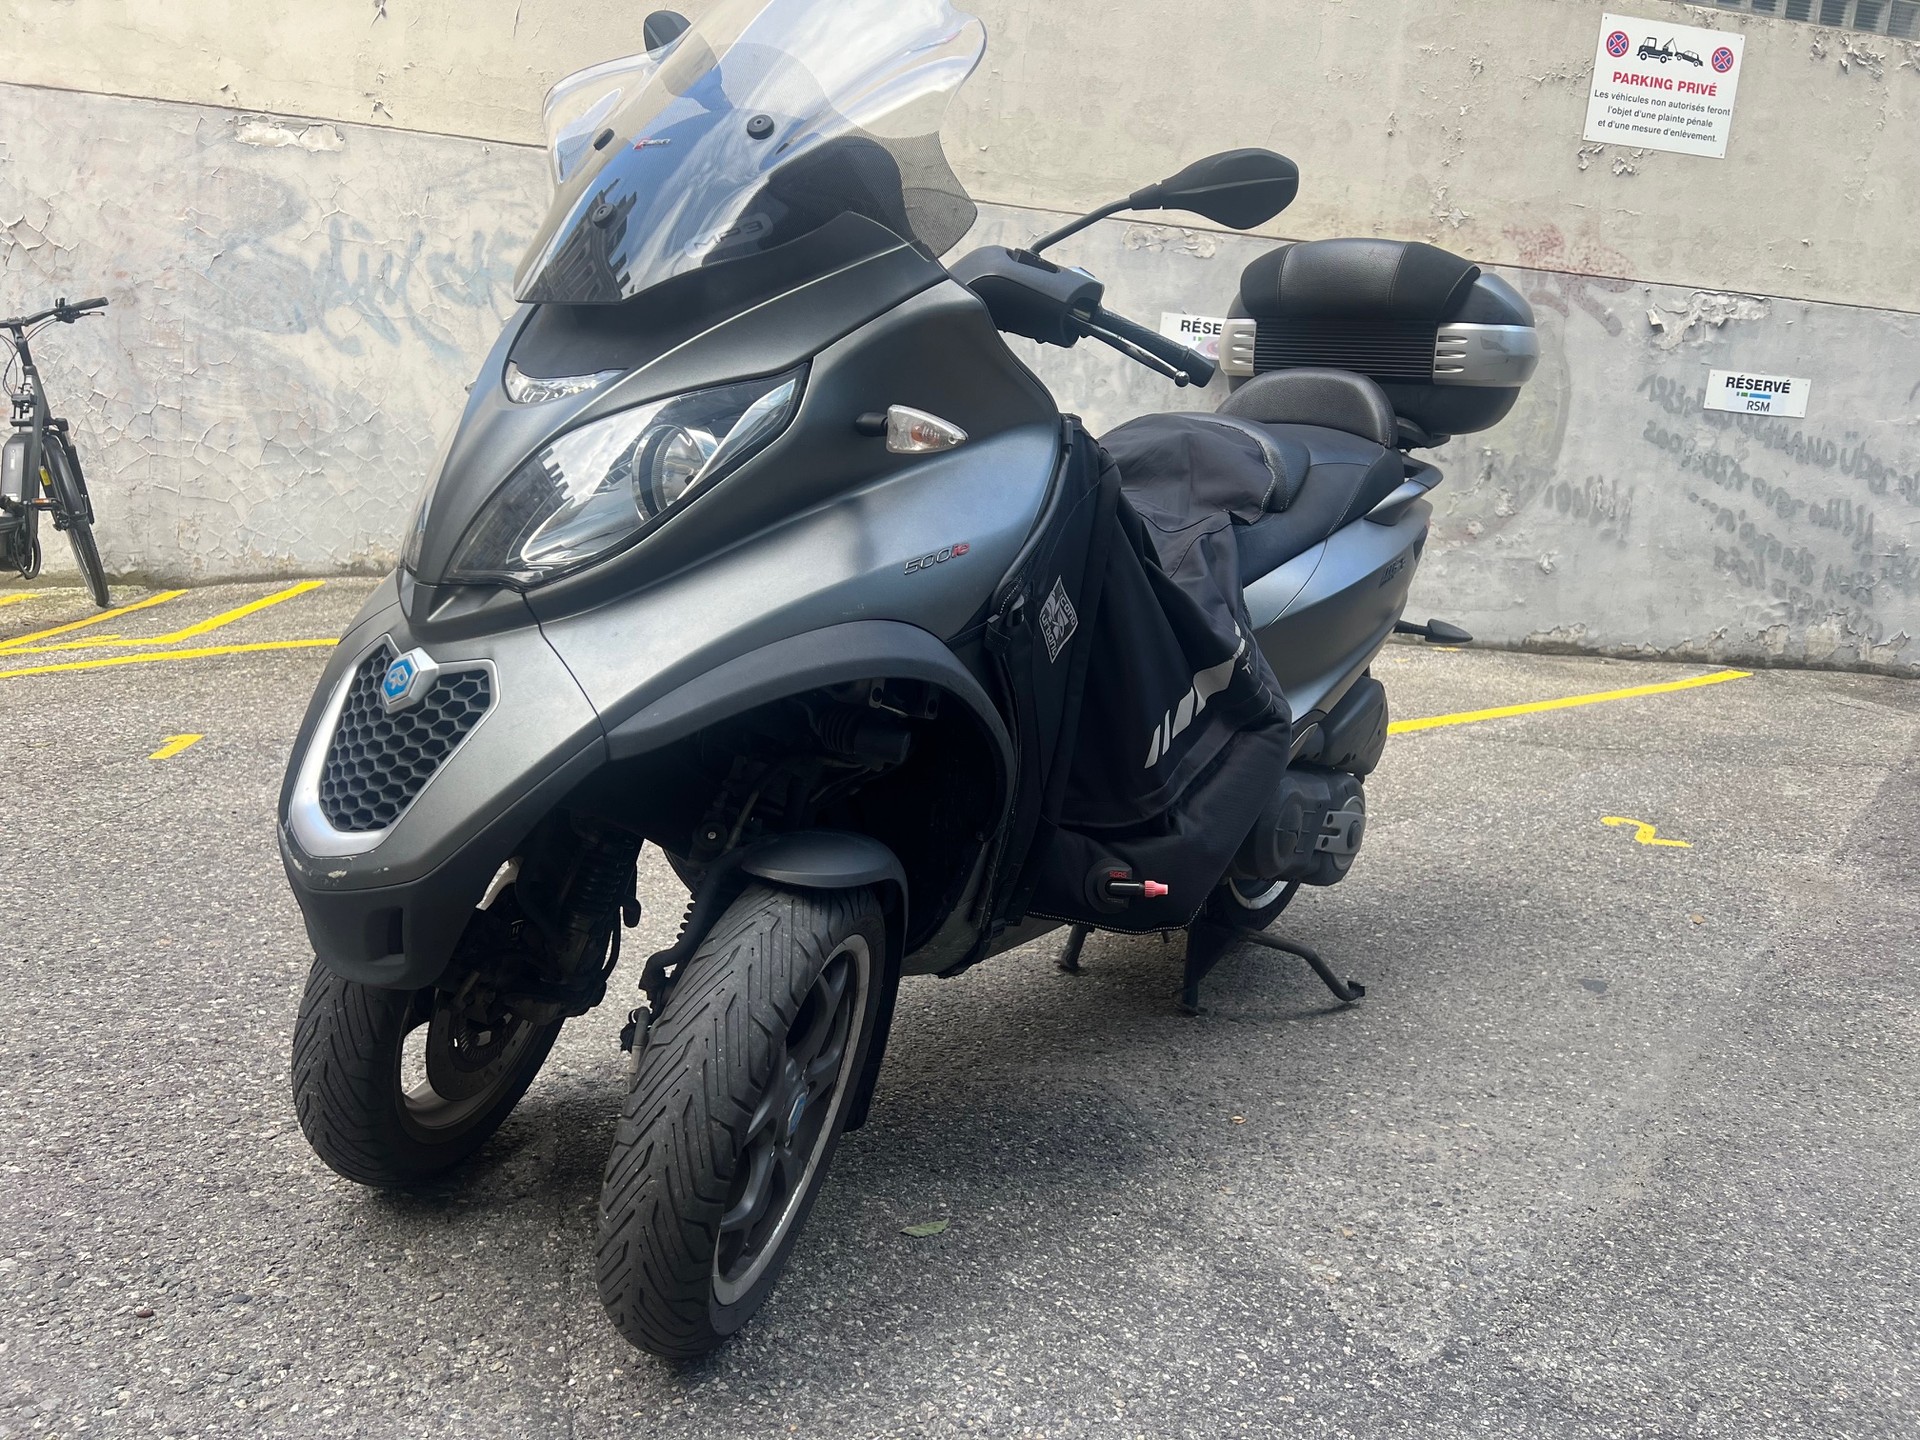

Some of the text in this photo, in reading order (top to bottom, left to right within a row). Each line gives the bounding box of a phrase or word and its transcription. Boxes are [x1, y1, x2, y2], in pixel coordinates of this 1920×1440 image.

[1612, 71, 1718, 97] PARKING PRIVÉ
[1594, 89, 1731, 116] Les véhicules non autorisés feront
[1607, 105, 1713, 128] l'objet d'une plainte pénale
[1597, 119, 1718, 143] et d'une mesure d'enlèvement.
[694, 220, 763, 250] MP3
[1726, 375, 1791, 394] RÉSERVÉ
[1746, 400, 1771, 412] RSM
